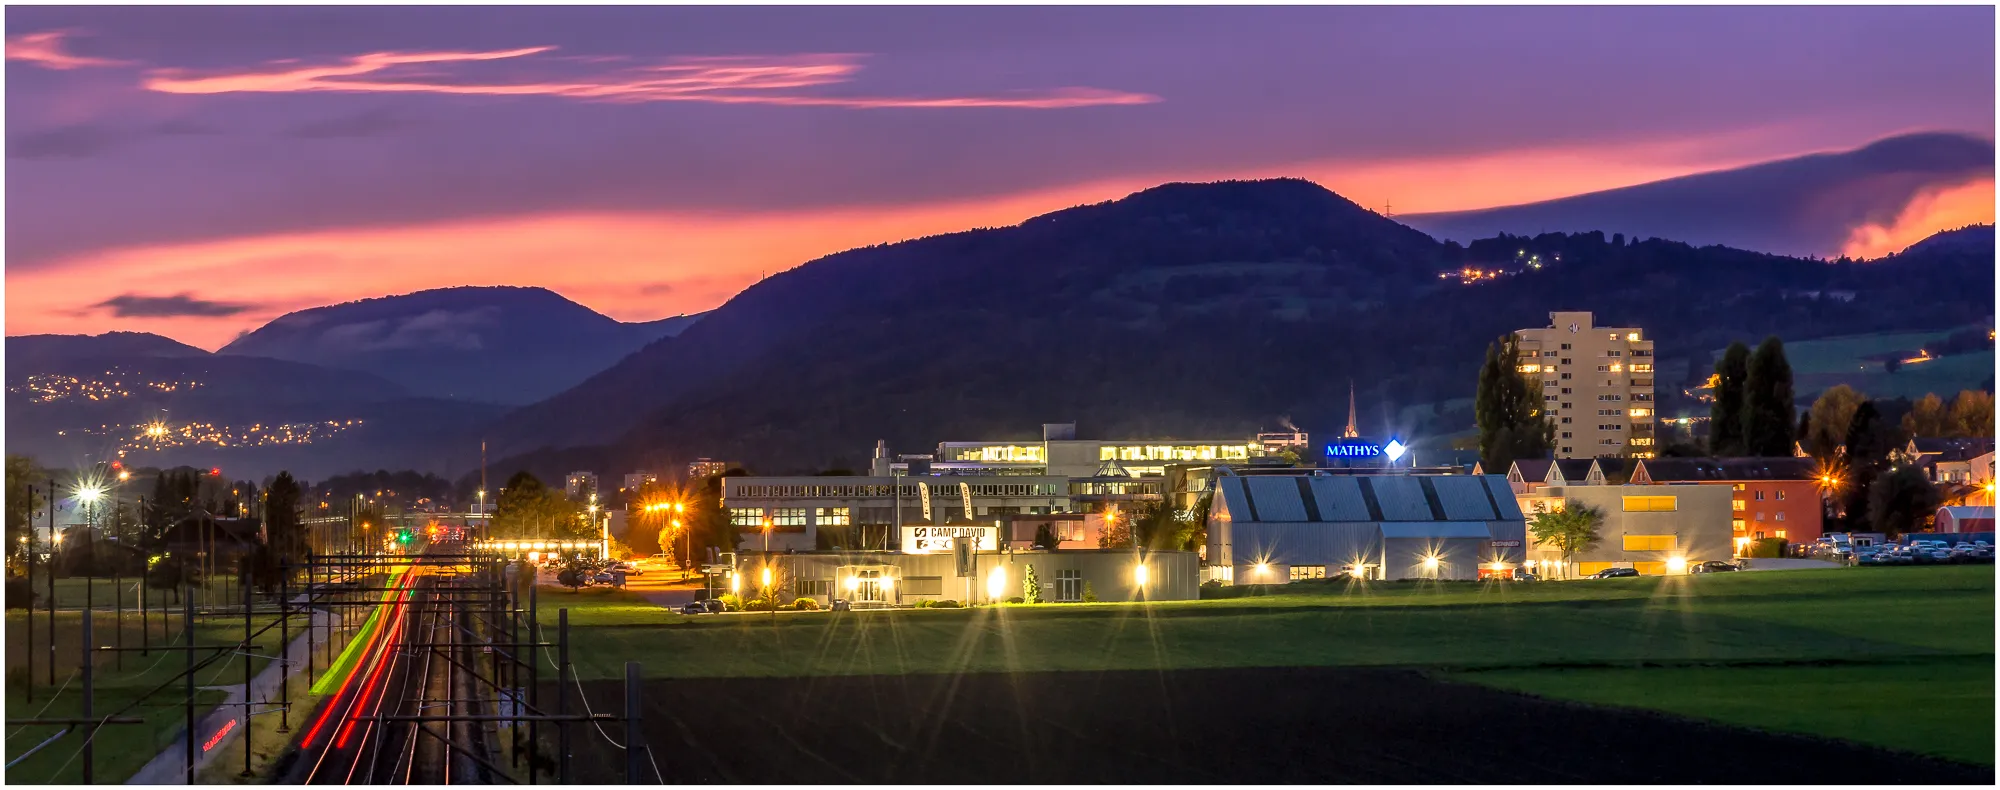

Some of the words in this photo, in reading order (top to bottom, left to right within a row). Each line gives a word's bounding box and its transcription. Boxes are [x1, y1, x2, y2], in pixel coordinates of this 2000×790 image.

[1326, 445, 1380, 456] MATHYS
[931, 527, 957, 537] CAMP
[959, 527, 985, 537] DAVID
